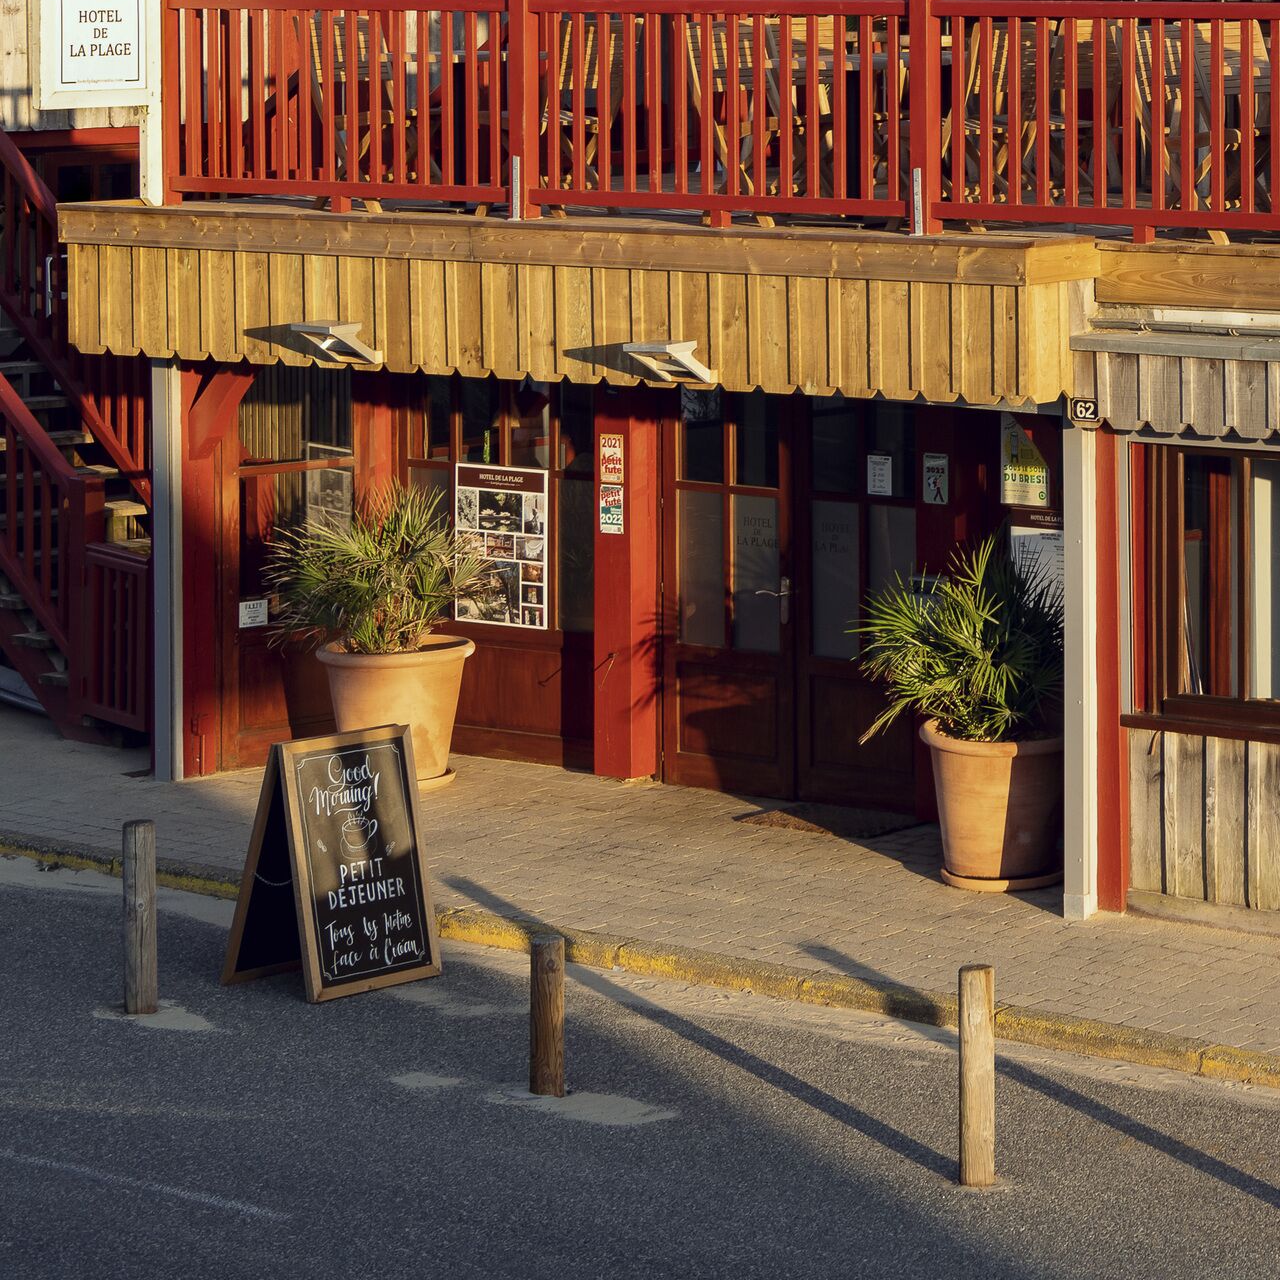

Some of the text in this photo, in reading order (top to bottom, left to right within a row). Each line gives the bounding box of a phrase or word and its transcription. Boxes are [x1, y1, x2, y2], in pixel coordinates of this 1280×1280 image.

[79, 9, 123, 23] HOTEL
[93, 27, 108, 39] DE
[70, 42, 132, 57] LA PLAGE
[1076, 401, 1095, 418] 62
[601, 437, 621, 448] 2021
[1003, 473, 1017, 482] DU
[600, 513, 622, 523] 2022
[327, 754, 375, 788] Good
[309, 772, 379, 816] Morning!
[340, 858, 383, 883] PETIT
[328, 876, 406, 910] DÉJEUNER
[324, 920, 355, 951] Tous
[363, 916, 379, 941] les
[330, 950, 363, 975] face
[369, 943, 380, 961] à
